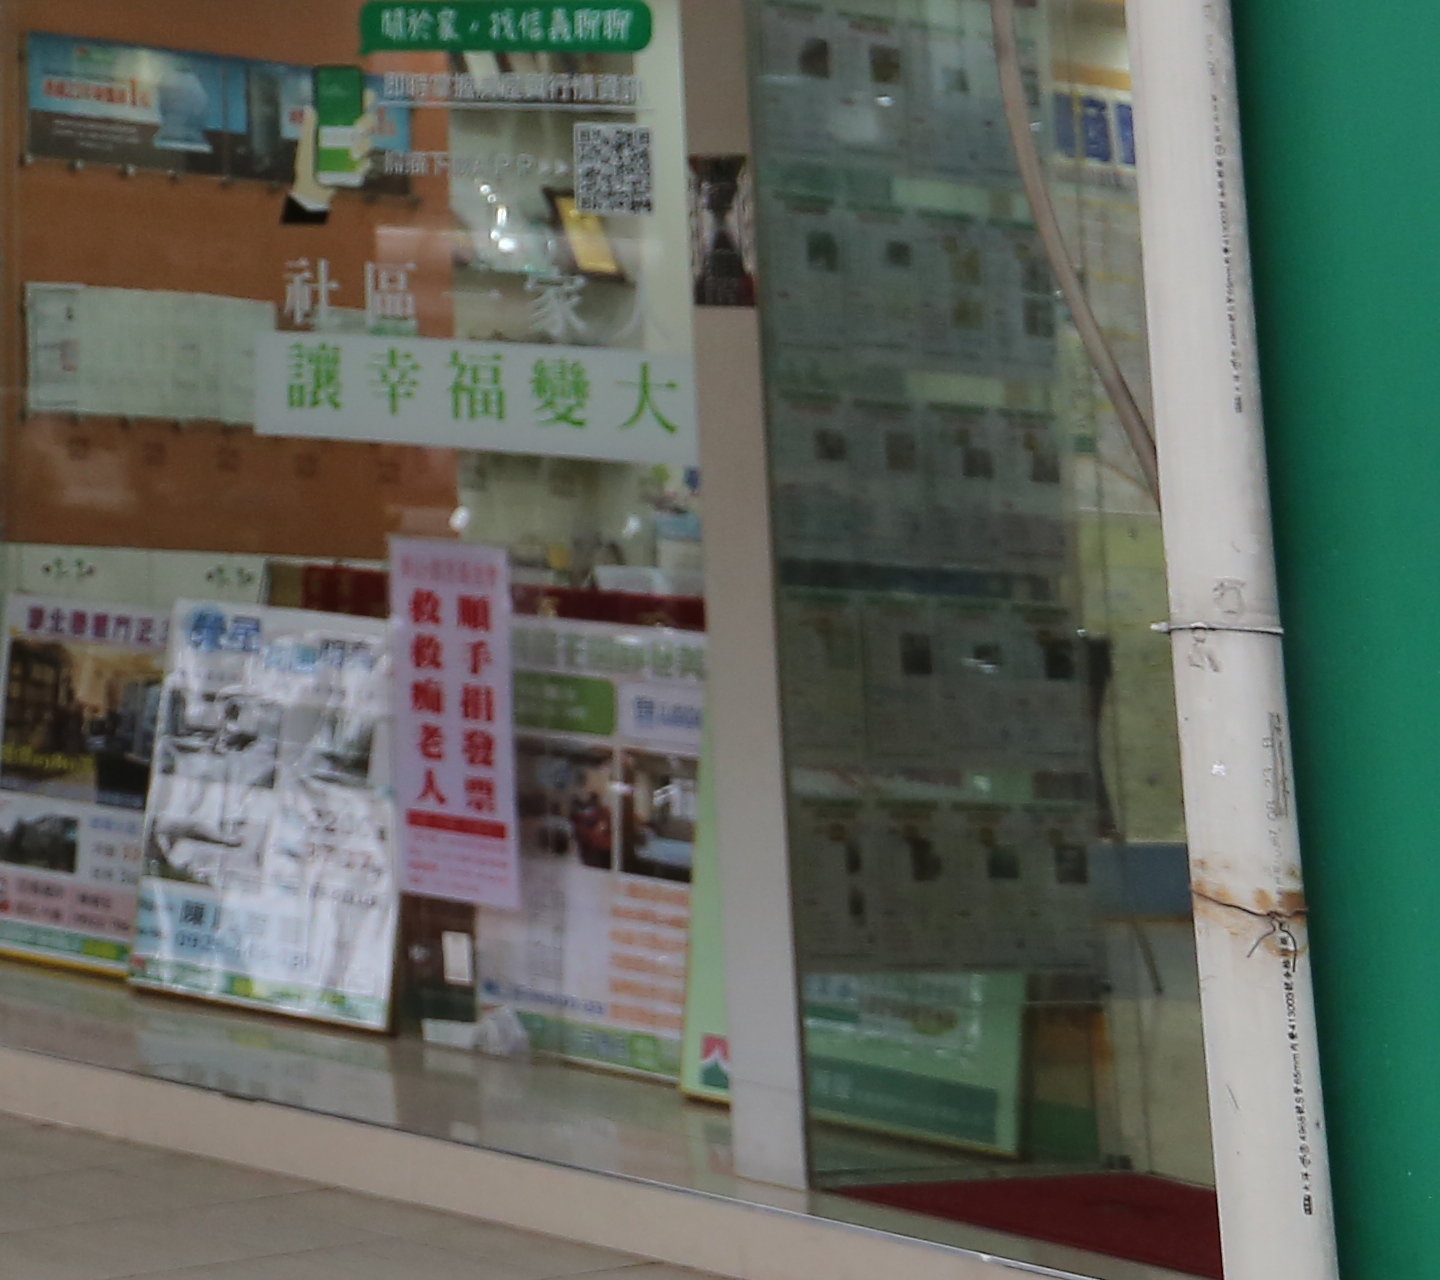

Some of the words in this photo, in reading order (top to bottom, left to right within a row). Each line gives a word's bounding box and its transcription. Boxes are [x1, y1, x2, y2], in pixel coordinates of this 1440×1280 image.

[287, 342, 678, 436] 讓幸福變大
[458, 594, 496, 812] 順手捐發票
